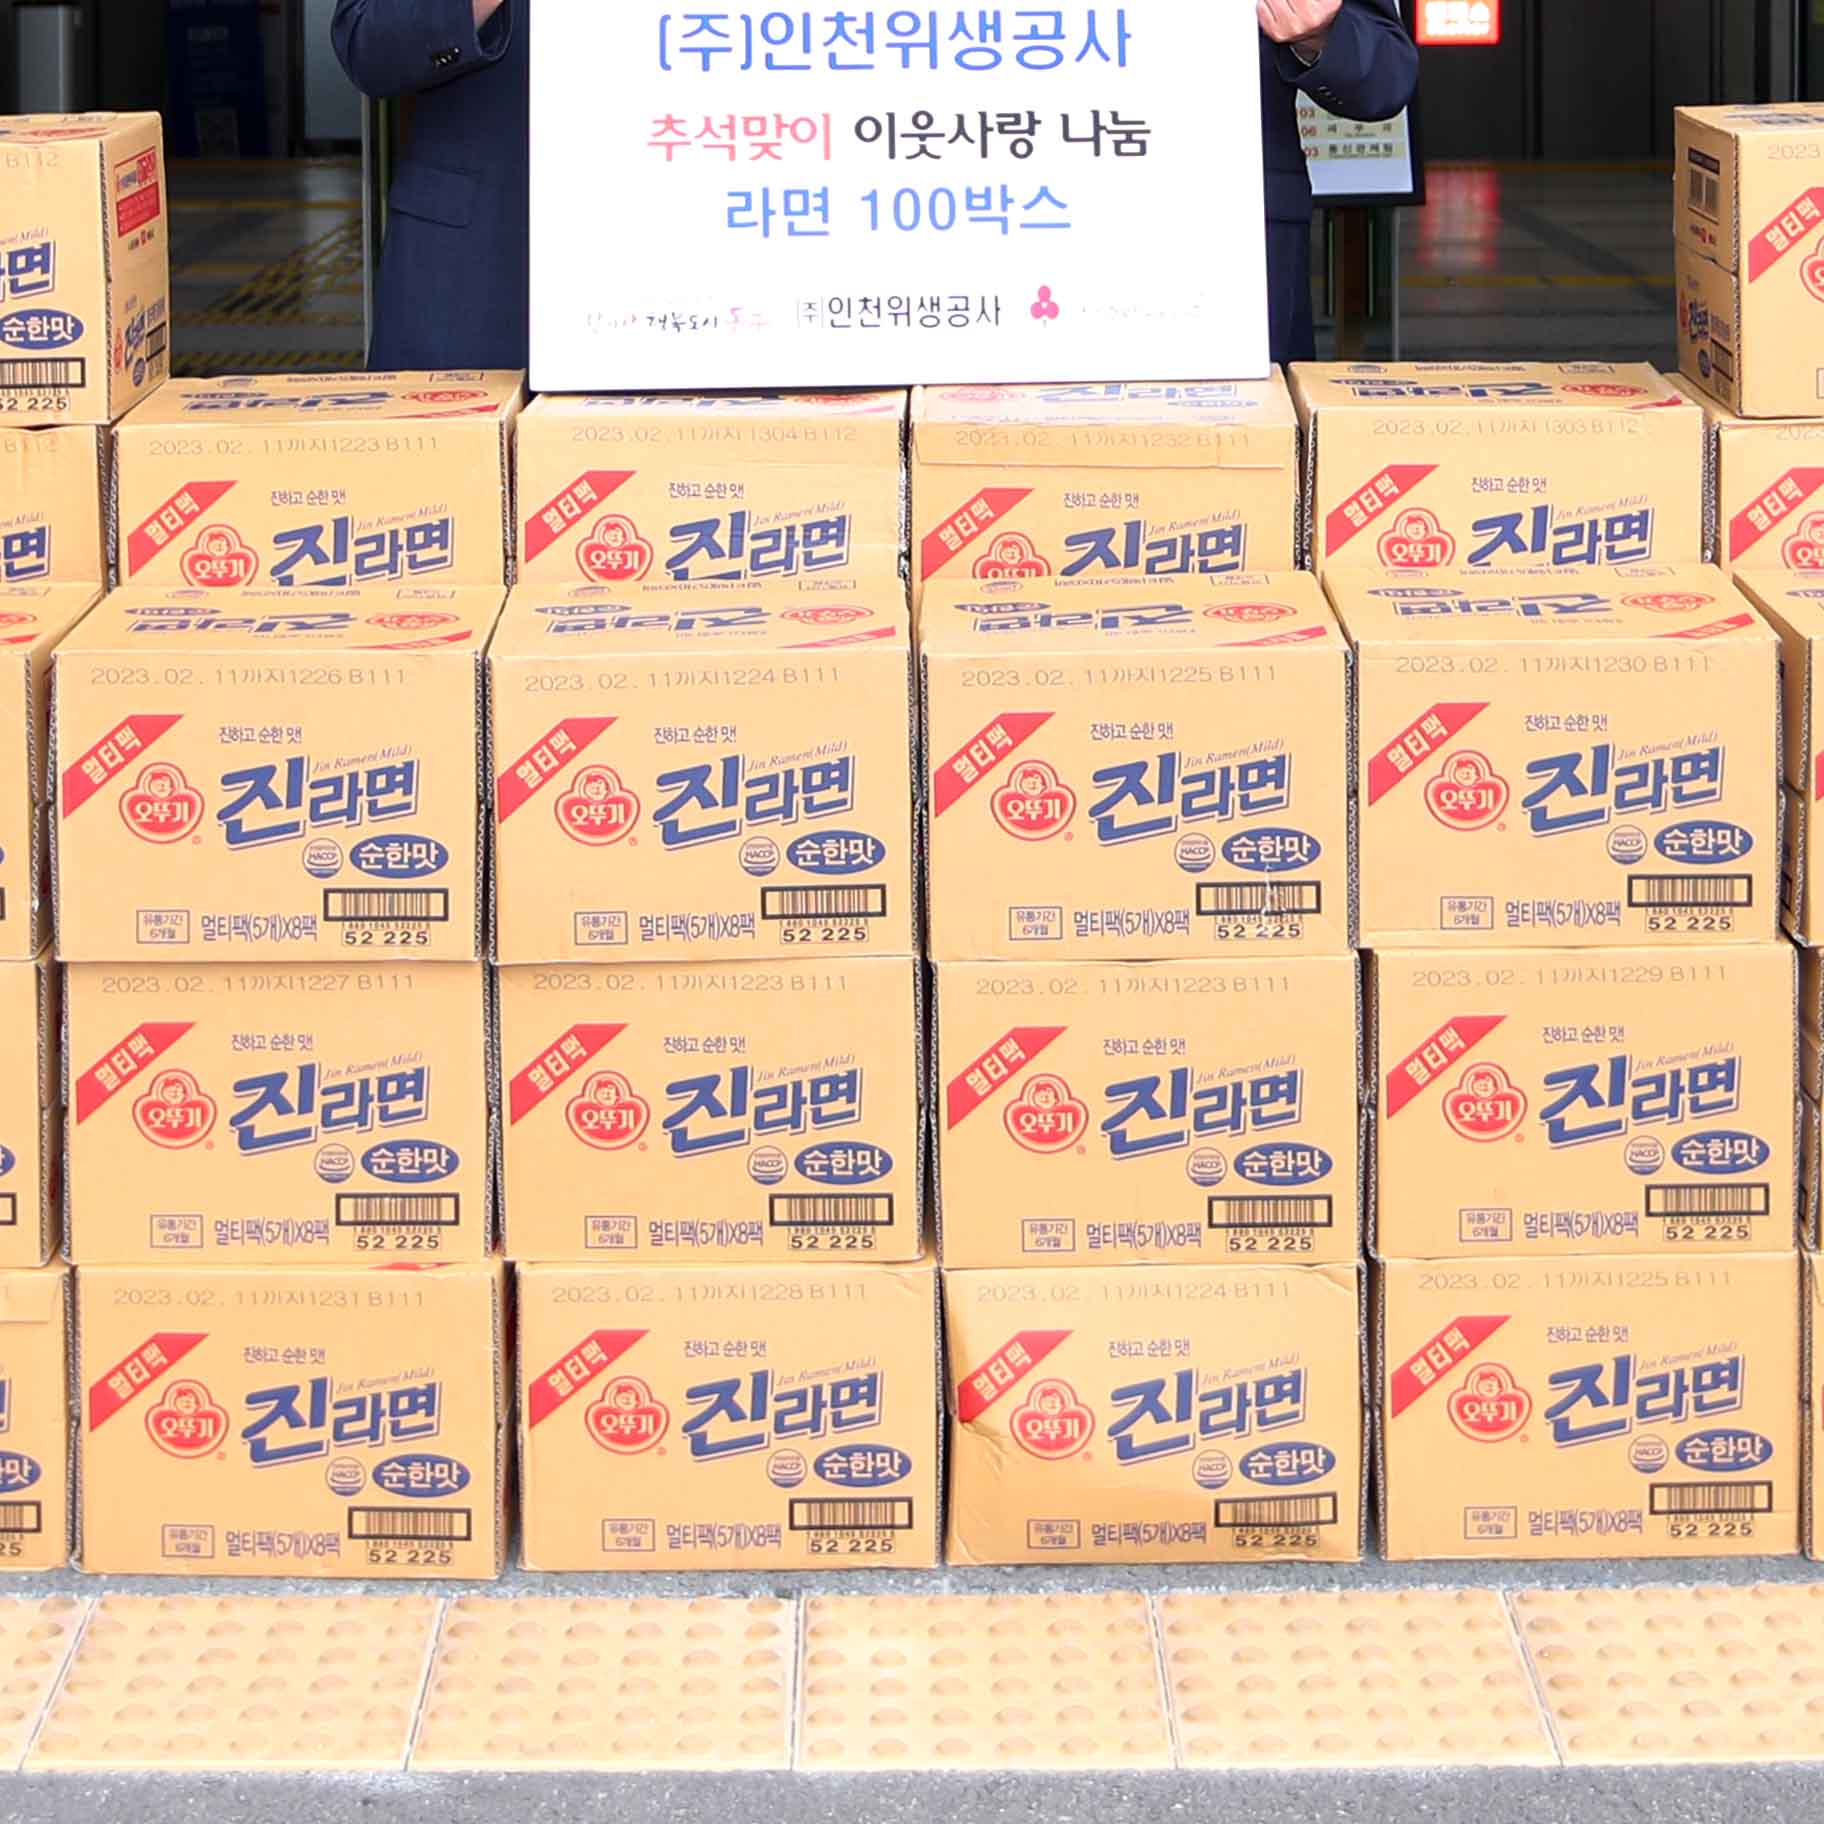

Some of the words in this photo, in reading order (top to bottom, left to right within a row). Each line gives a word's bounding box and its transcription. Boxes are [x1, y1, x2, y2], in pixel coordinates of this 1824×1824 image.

[647, 113, 831, 162] 추석맞이
[854, 110, 1041, 160] 이웃사랑
[1059, 109, 1152, 158] 나눔
[726, 186, 830, 238] 라면
[860, 184, 1072, 237] 100박스
[2, 316, 75, 342] 순한맛
[28, 398, 68, 411] 225
[515, 729, 577, 790] 멀티팩
[570, 804, 625, 826] 오뚜기
[652, 754, 855, 851] 진라면
[795, 838, 876, 866] 순한맛
[782, 930, 811, 943] 52
[823, 928, 867, 942] 225
[1458, 1101, 1512, 1124] 오뚜기
[1462, 1401, 1517, 1423] 오뚜기
[1543, 1353, 1745, 1448] 진라면
[1683, 1436, 1764, 1464] 순한맛
